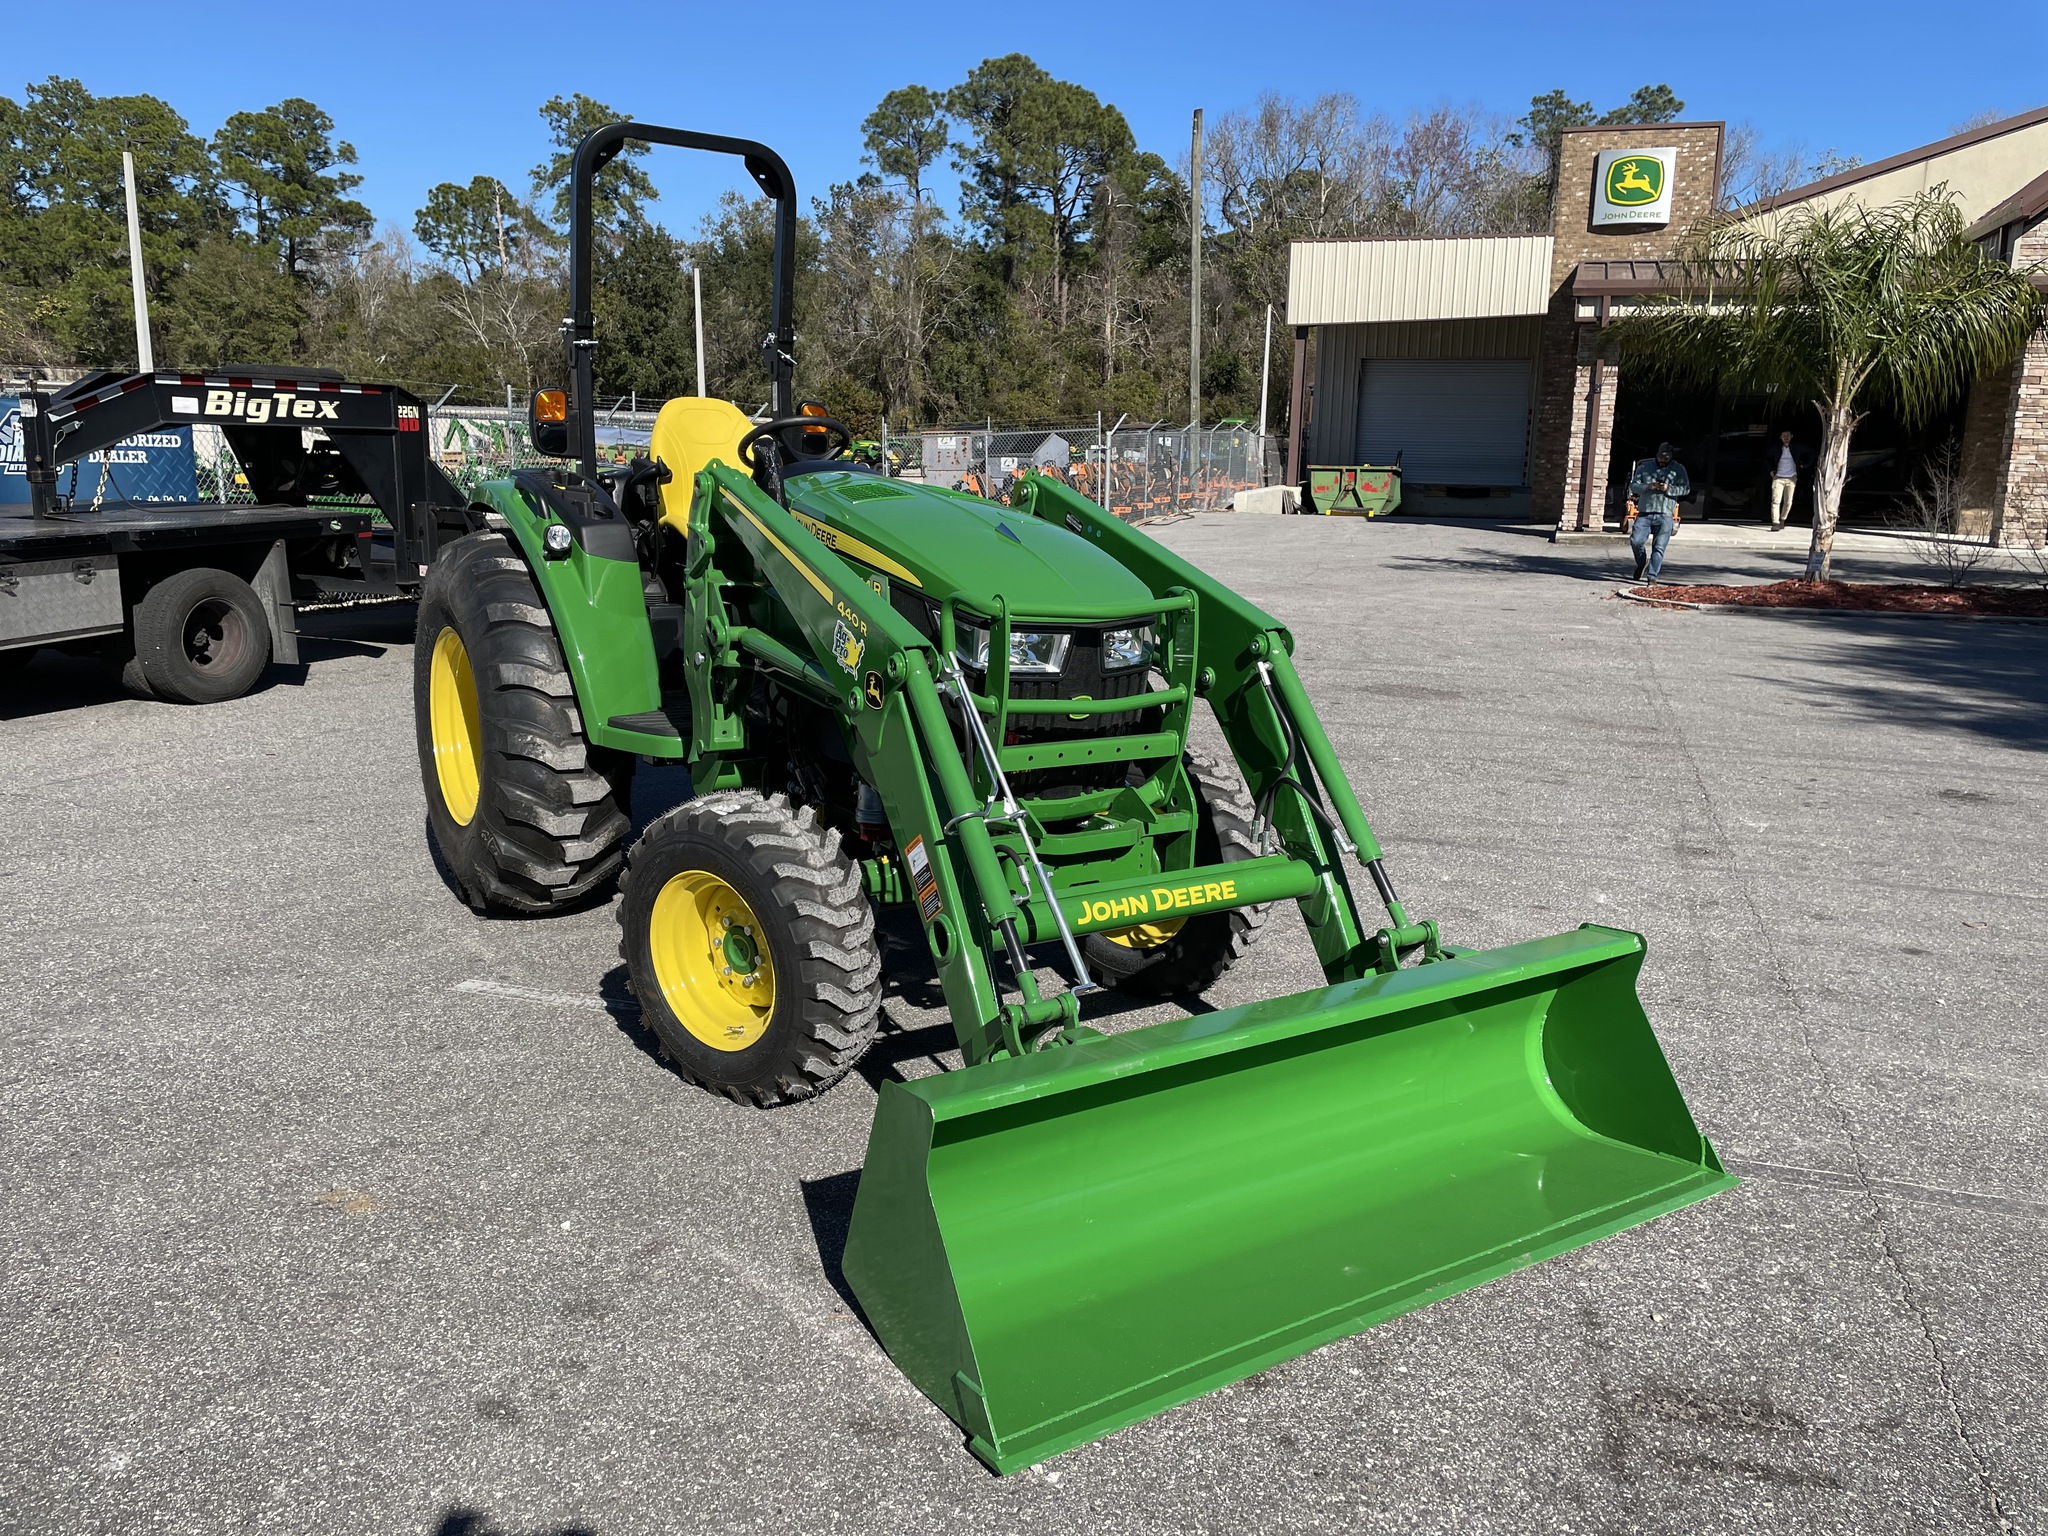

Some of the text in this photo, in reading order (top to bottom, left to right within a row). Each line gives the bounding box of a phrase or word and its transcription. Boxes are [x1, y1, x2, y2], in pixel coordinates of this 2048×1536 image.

[1601, 211, 1662, 220] JOHN DEERE
[204, 390, 340, 423] BigTex
[398, 418, 420, 432] HD
[116, 434, 182, 448] ORIZED
[811, 522, 838, 548] DEERE
[1077, 880, 1238, 926] JOHN DEERE
